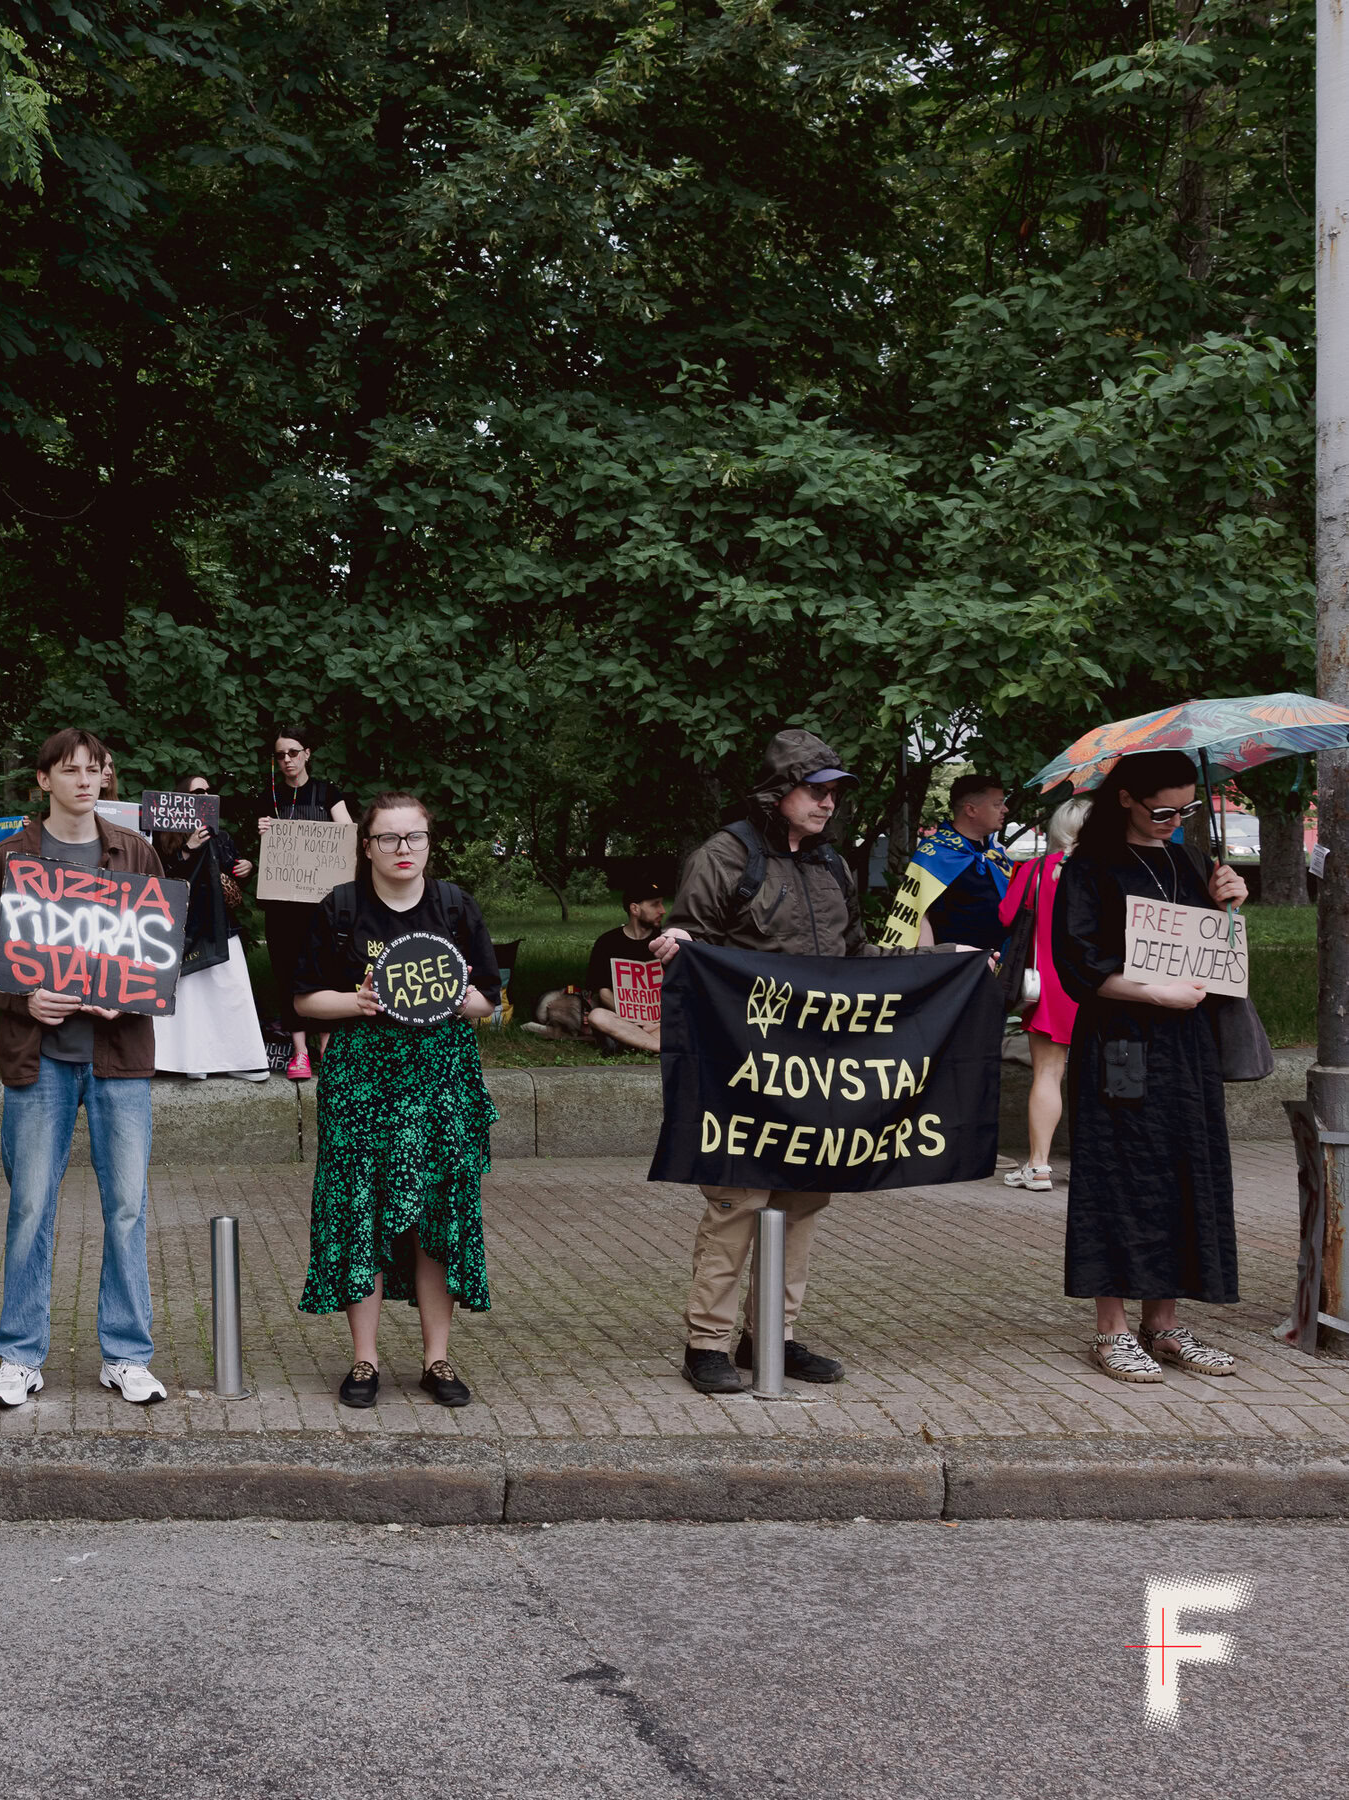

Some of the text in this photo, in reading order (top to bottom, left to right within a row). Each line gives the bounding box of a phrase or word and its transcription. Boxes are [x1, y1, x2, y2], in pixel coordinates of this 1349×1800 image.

[1132, 903, 1187, 936] FREE
[386, 954, 452, 992] FREE
[615, 961, 664, 990] FRE
[1131, 938, 1246, 983] DEFENDERS
[394, 979, 459, 1008] AZOV
[617, 988, 661, 1004] UKRAIN
[619, 1002, 661, 1021] DEFEND
[798, 990, 902, 1033] FREE
[728, 1051, 930, 1101] AZOVSTAL
[701, 1111, 946, 1167] DEFENDERS
